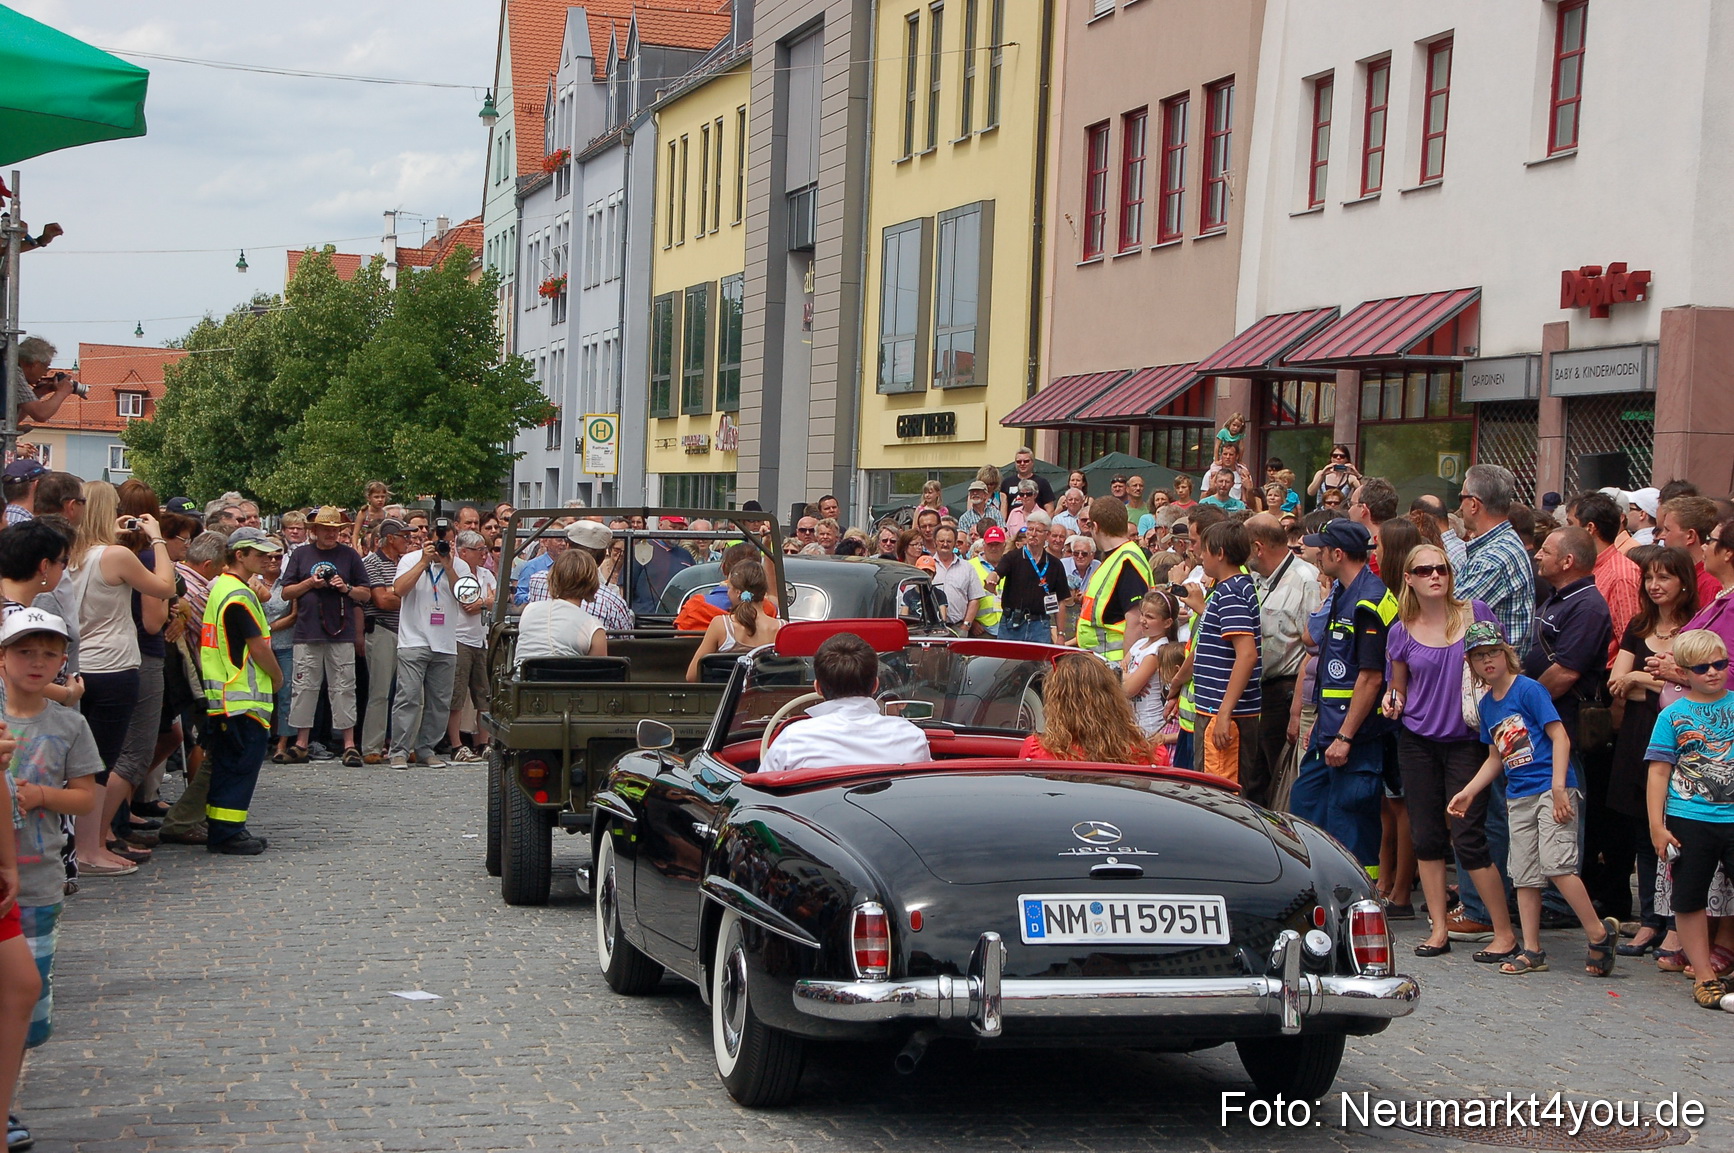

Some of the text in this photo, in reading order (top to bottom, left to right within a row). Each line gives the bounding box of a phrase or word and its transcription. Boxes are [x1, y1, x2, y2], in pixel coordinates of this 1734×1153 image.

[1560, 262, 1651, 318] Döpfer
[1471, 373, 1505, 387] GARDINEN
[1555, 362, 1639, 381] BABY & KINDERMODEN
[1031, 924, 1039, 933] D
[1045, 904, 1222, 935] NM H 595H
